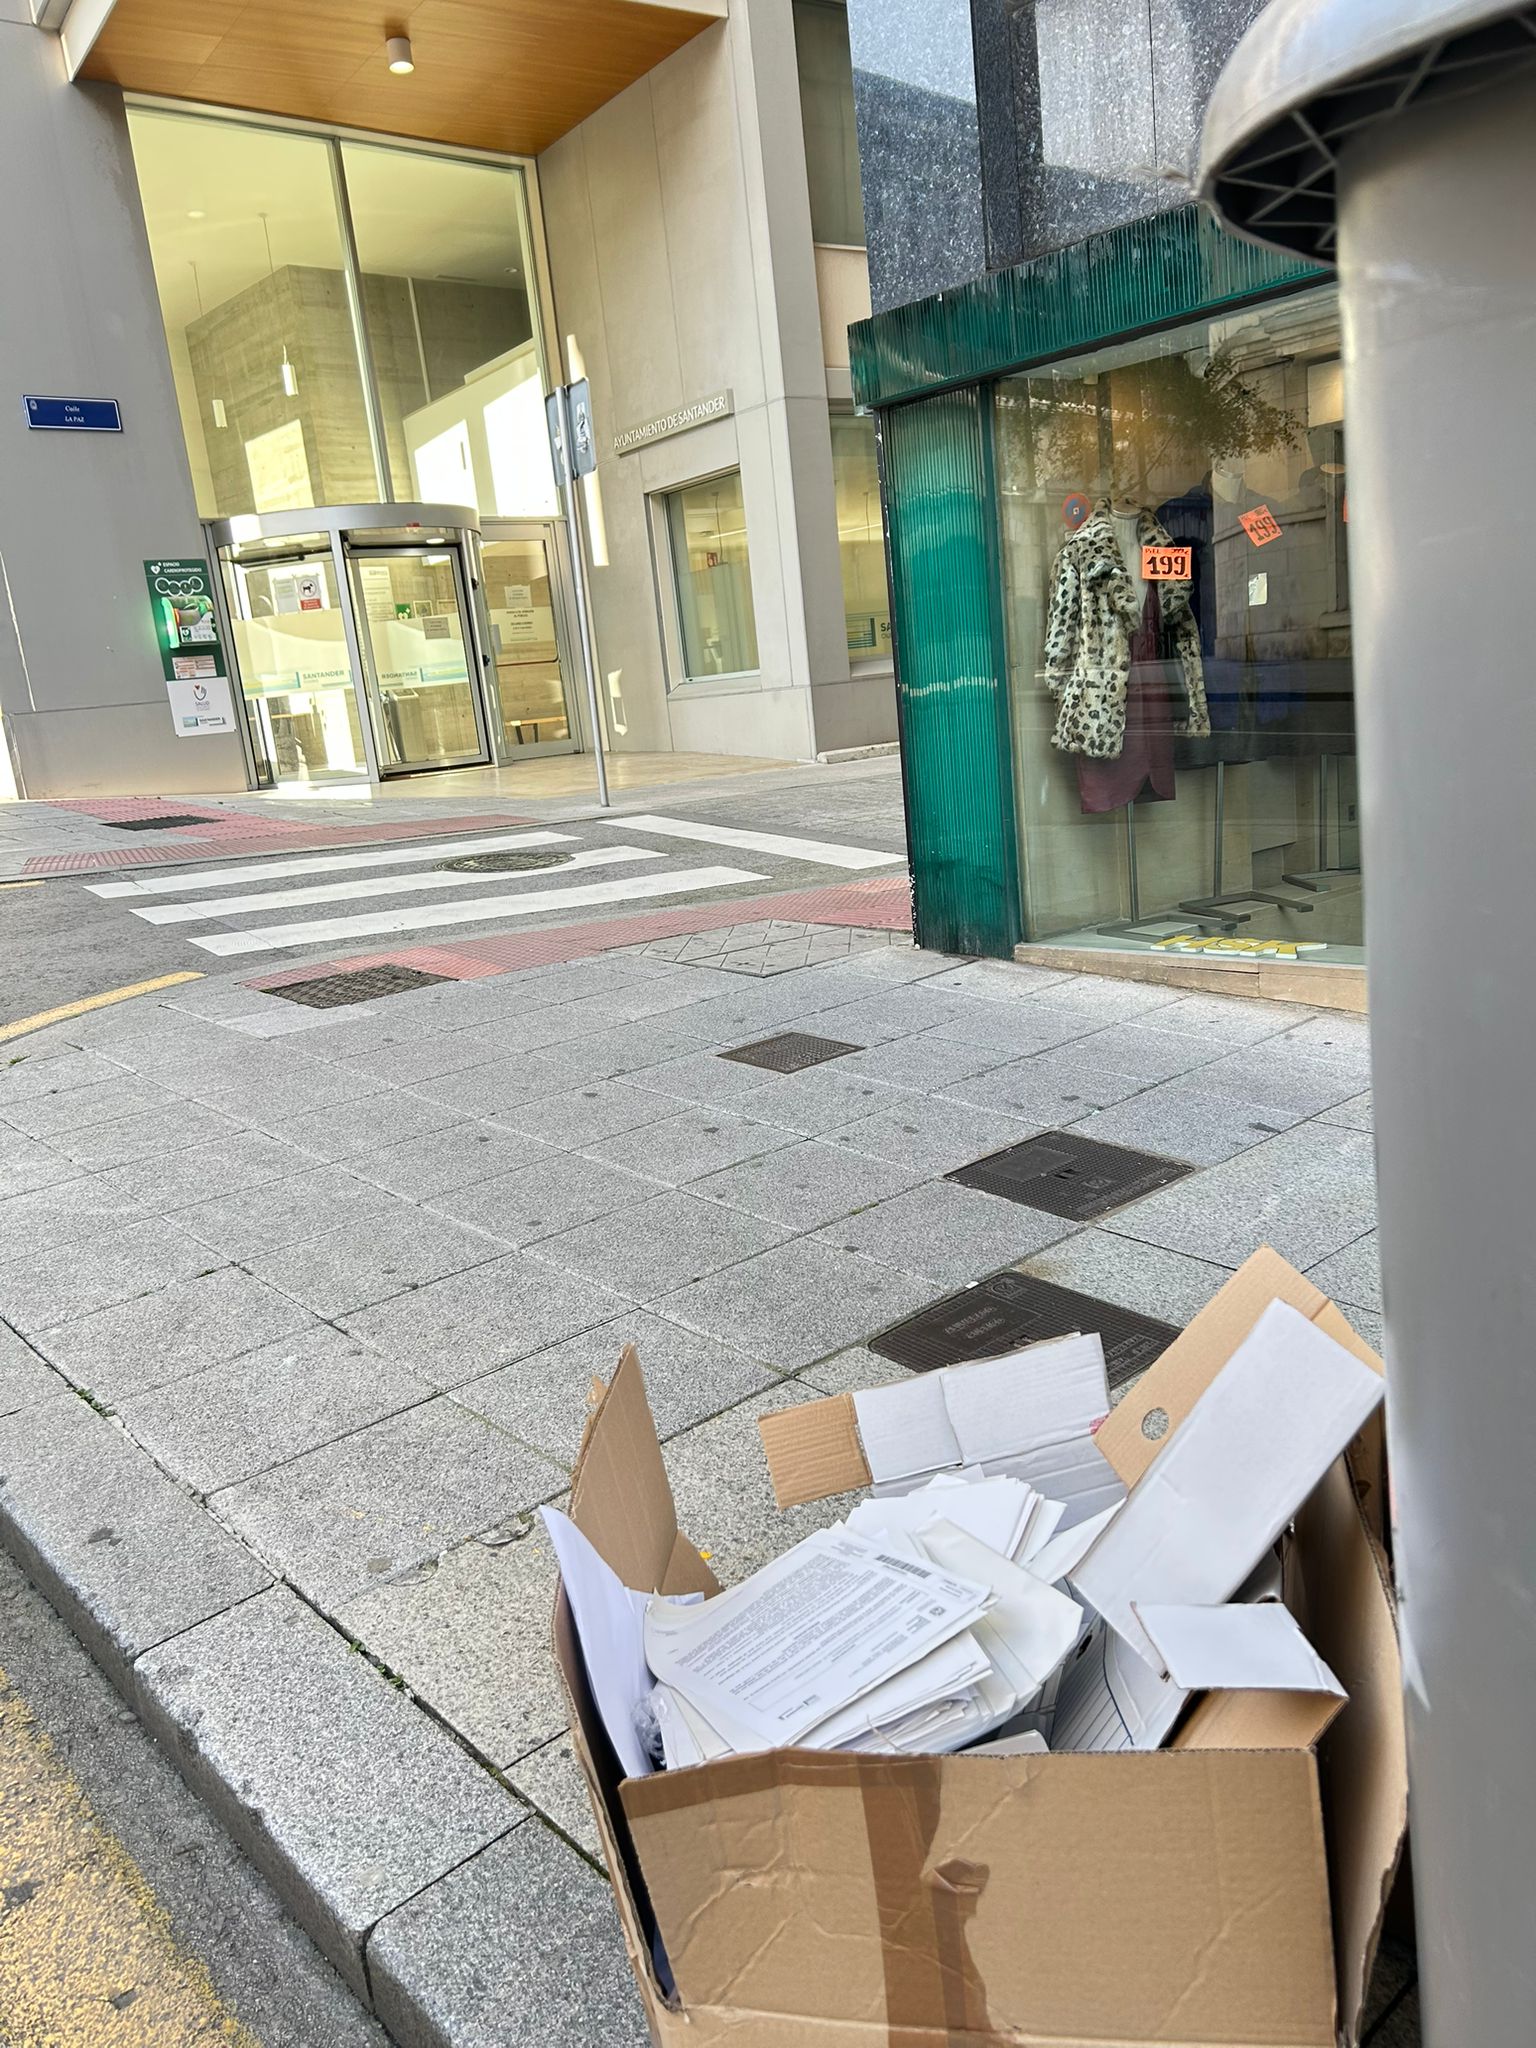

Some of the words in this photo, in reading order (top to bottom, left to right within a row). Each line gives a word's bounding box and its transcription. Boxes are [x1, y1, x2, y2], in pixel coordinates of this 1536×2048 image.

[613, 419, 667, 449] AYUNTAMIENTO
[667, 414, 679, 429] DE
[678, 396, 725, 424] SANTANDER
[1248, 515, 1278, 541] 199
[302, 669, 345, 680] SANTANDER
